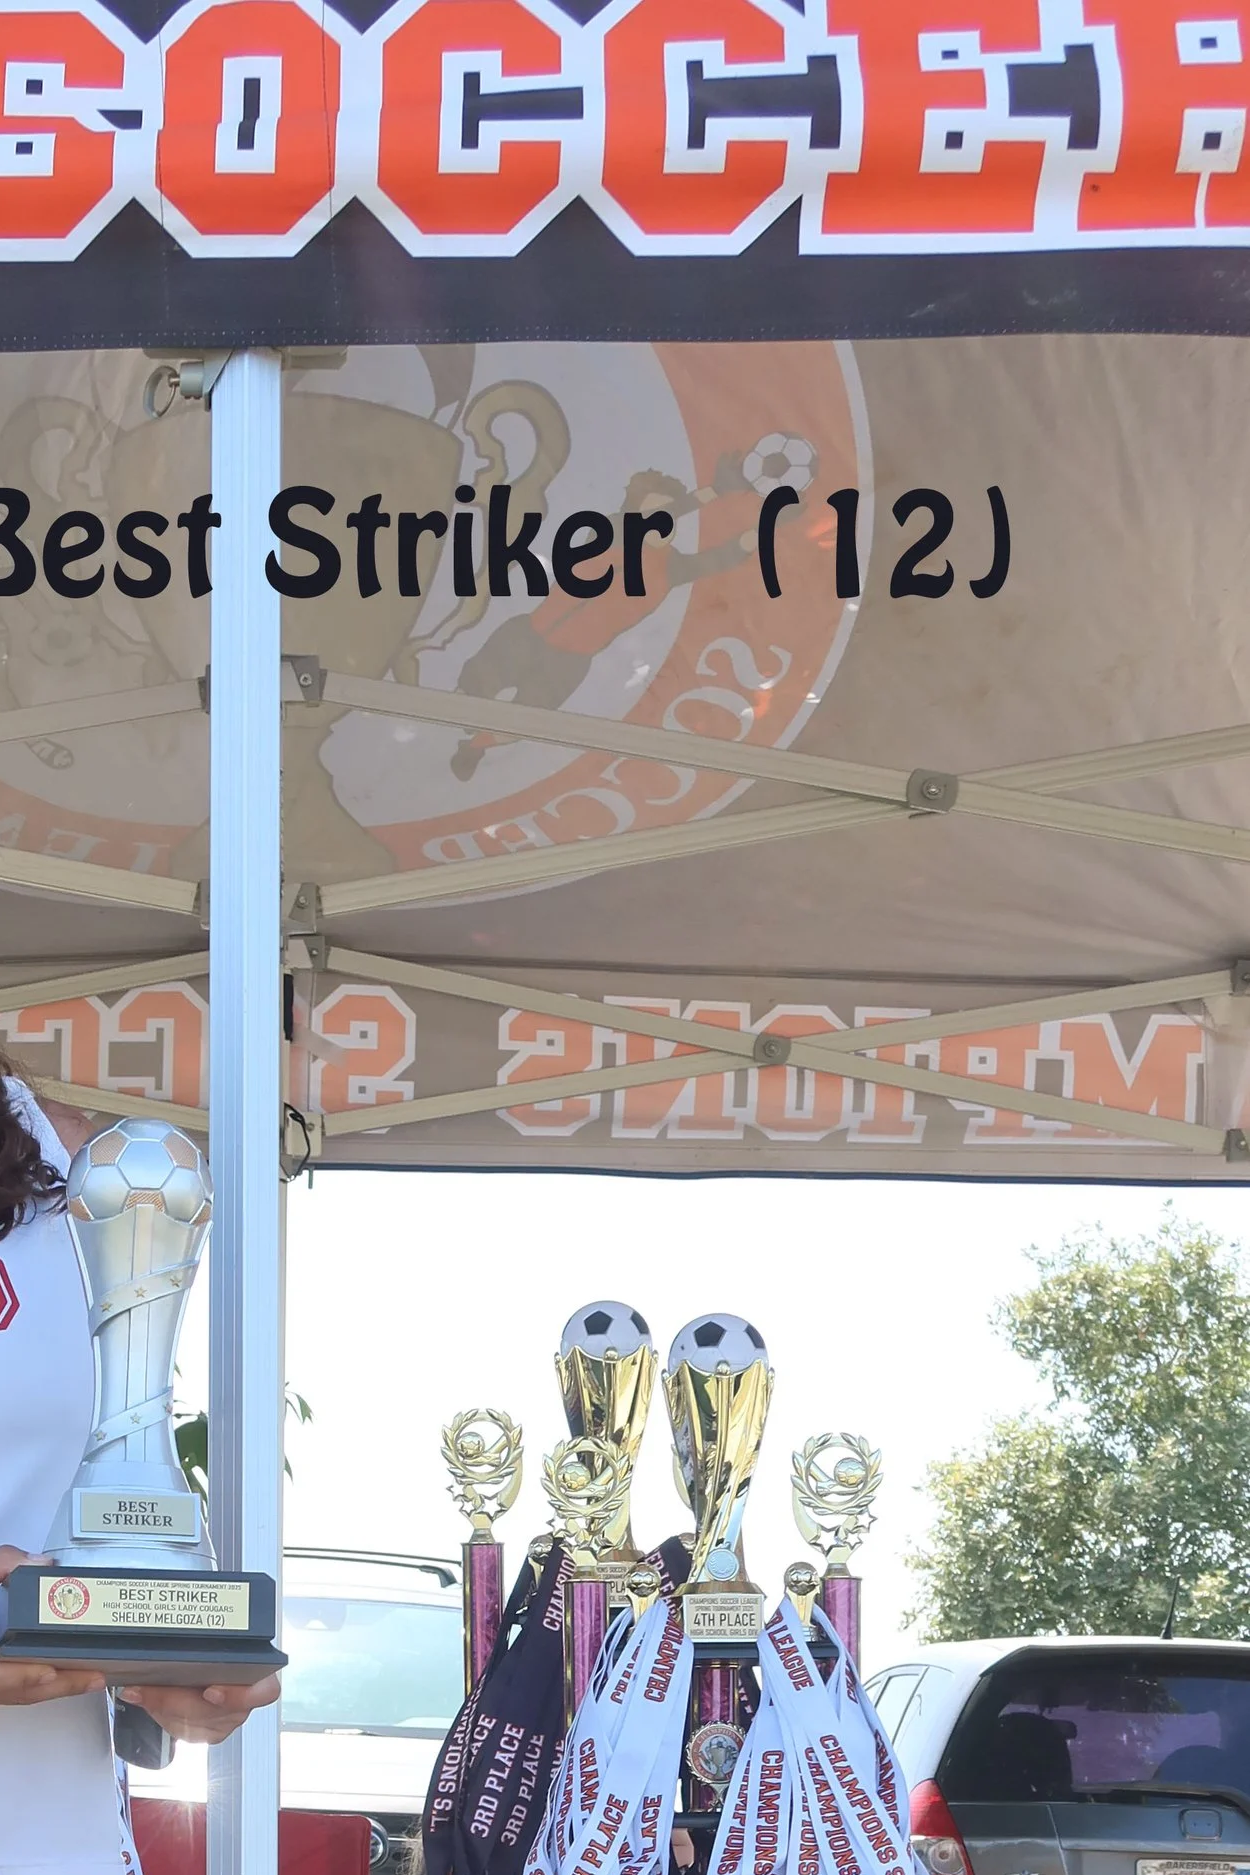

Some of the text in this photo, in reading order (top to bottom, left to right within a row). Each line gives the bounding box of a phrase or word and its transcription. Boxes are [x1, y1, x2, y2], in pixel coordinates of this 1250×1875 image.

[117, 1500, 158, 1513] BEST
[103, 1513, 173, 1527] STRIKER
[610, 1581, 626, 1594] PLA
[119, 1589, 218, 1603] BEST STRIKER
[123, 1602, 152, 1610] SCHOOL
[154, 1603, 176, 1611] GIRLS
[178, 1604, 197, 1612] LADY
[199, 1605, 234, 1613] COUGARS
[112, 1612, 225, 1627] SHELBY MELGOZA (12)
[693, 1613, 715, 1626] 4TH
[719, 1613, 756, 1626] PLACE
[767, 1625, 815, 1692] LEAGUE
[469, 1722, 526, 1839] 3RD PLACE
[578, 1737, 600, 1814] CHAMP
[500, 1804, 528, 1847] 3RD
[517, 1734, 545, 1802] PLACE
[819, 1734, 899, 1864] CHAMPIONS
[580, 1793, 630, 1869] PLACE
